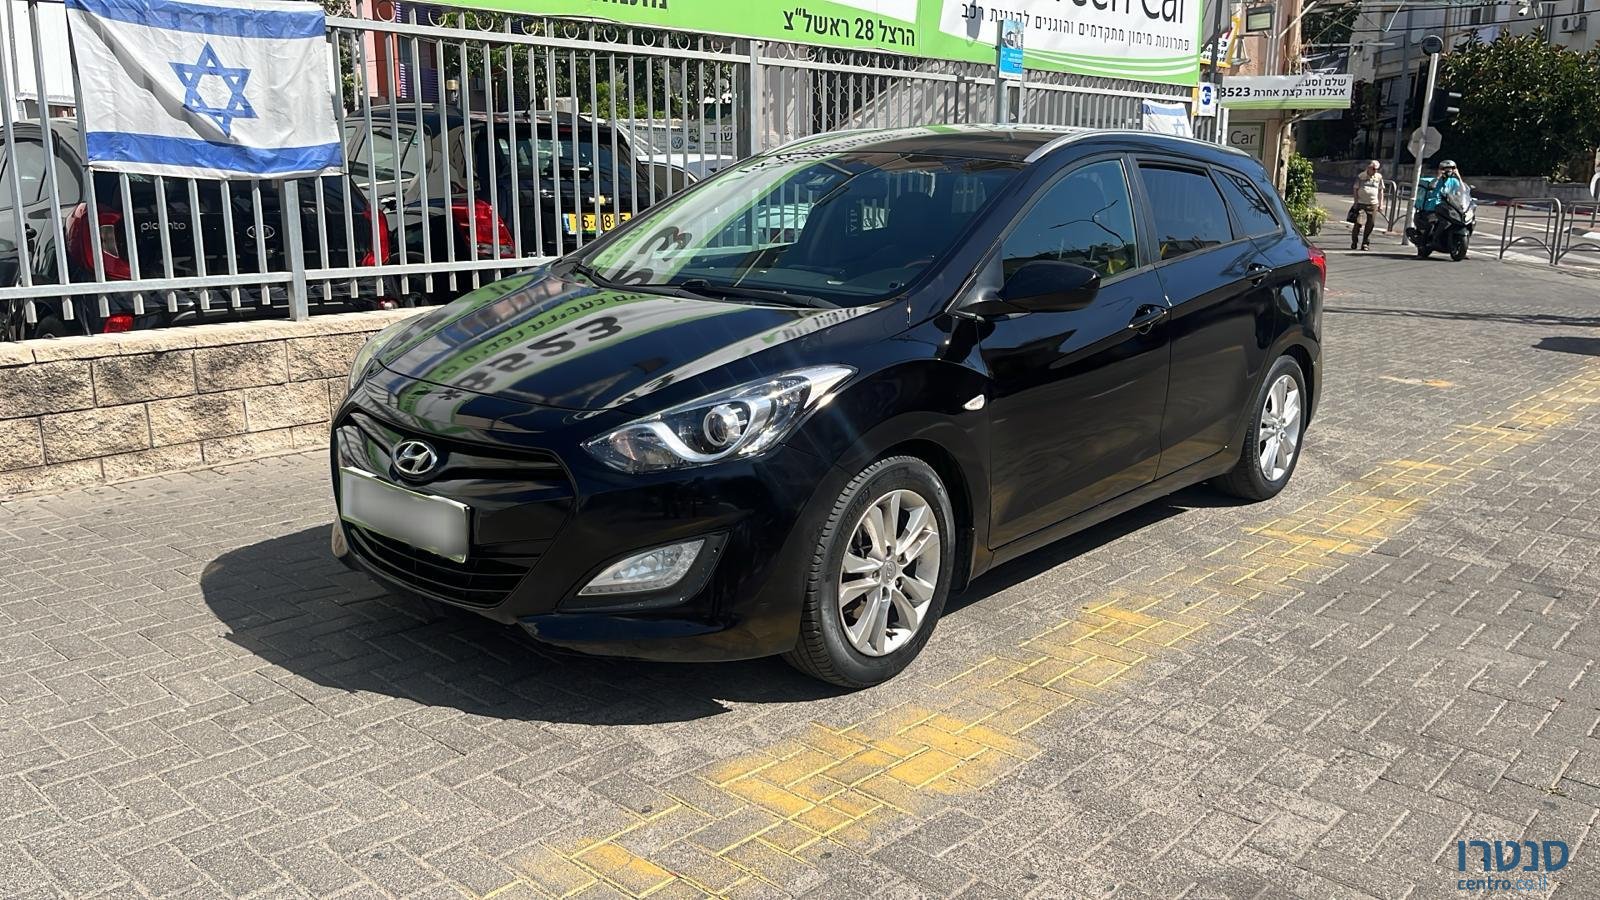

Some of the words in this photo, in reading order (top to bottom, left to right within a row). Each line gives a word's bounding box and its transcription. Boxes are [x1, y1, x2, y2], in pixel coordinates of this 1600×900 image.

[961, 3, 984, 21] רכב
[854, 17, 874, 40] 28
[1035, 15, 1074, 34] והוגנים
[879, 20, 915, 46] הרצל
[1079, 22, 1124, 43] מתקדמים
[1128, 30, 1153, 47] מימון
[1155, 35, 1190, 51] פתרונות
[1324, 77, 1347, 87] שלם
[1253, 88, 1279, 97] אחרת
[1281, 88, 1302, 98] קצת
[1305, 88, 1316, 96] זה
[1319, 87, 1346, 96] אצלנו
[1230, 130, 1256, 145] Car
[140, 220, 186, 232] picnto
